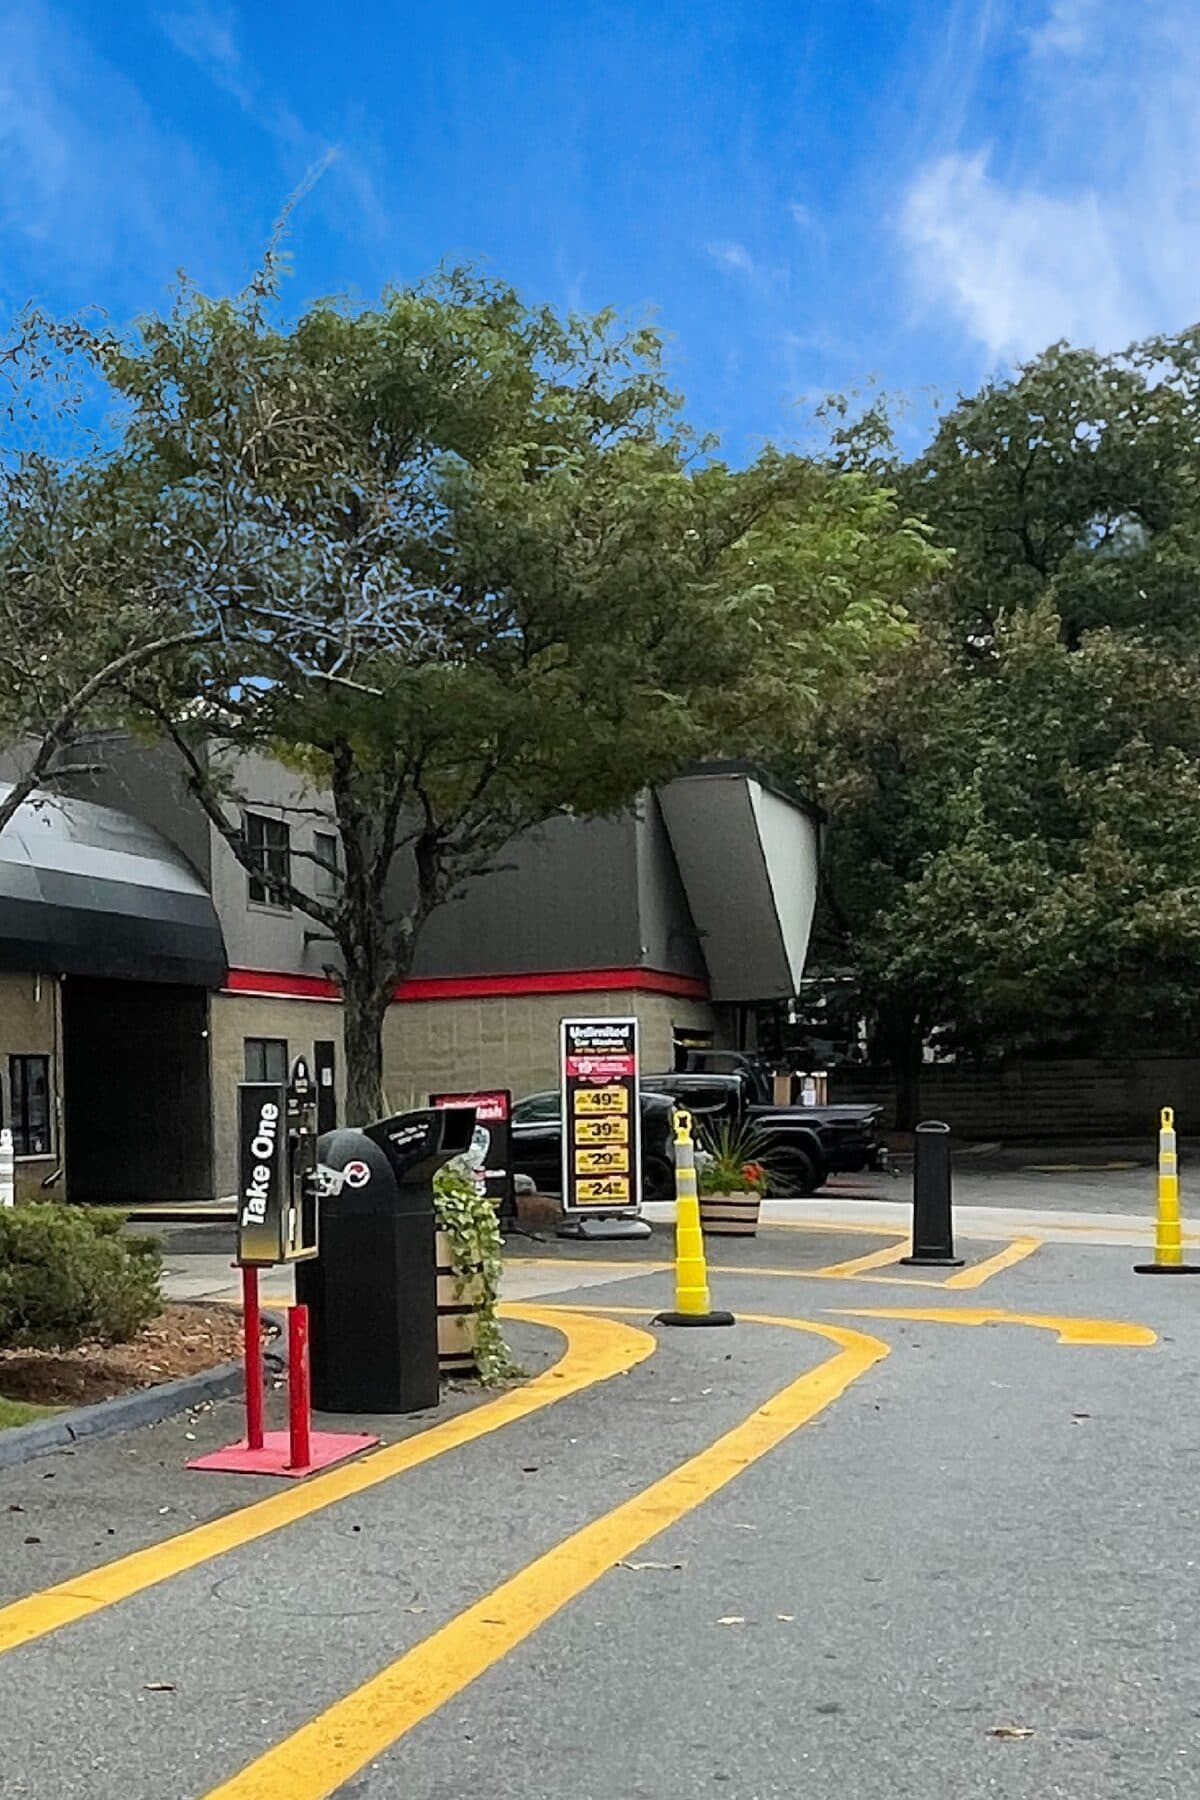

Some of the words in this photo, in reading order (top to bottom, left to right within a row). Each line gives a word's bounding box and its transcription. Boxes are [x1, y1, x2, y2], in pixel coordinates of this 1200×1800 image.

[569, 1026, 629, 1038] Unlimited
[251, 1103, 279, 1159] One
[241, 1165, 271, 1226] Take
